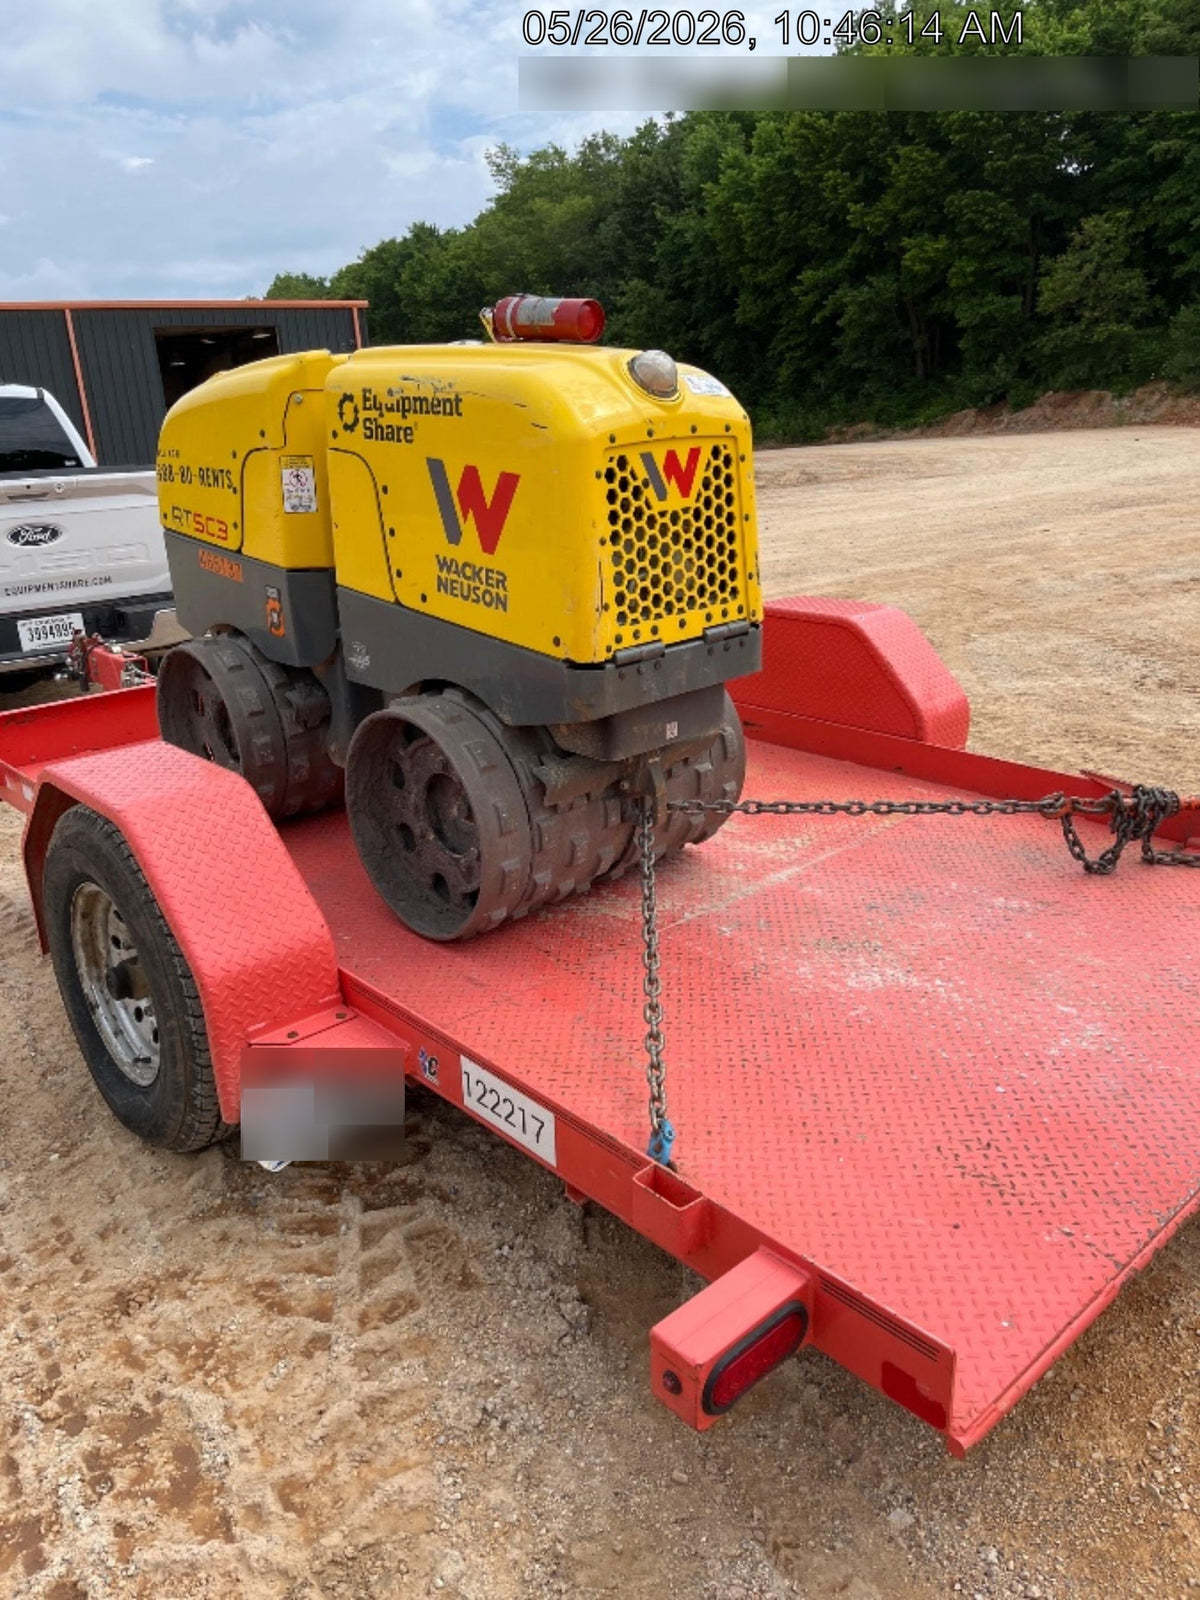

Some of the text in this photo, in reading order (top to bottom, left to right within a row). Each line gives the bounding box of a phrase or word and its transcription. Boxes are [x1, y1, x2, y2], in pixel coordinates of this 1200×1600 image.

[362, 388, 463, 419] Equipment
[362, 417, 414, 444] Share
[435, 554, 509, 592] WACKER
[436, 574, 508, 613] NEUSON
[463, 1070, 545, 1144] 122217
